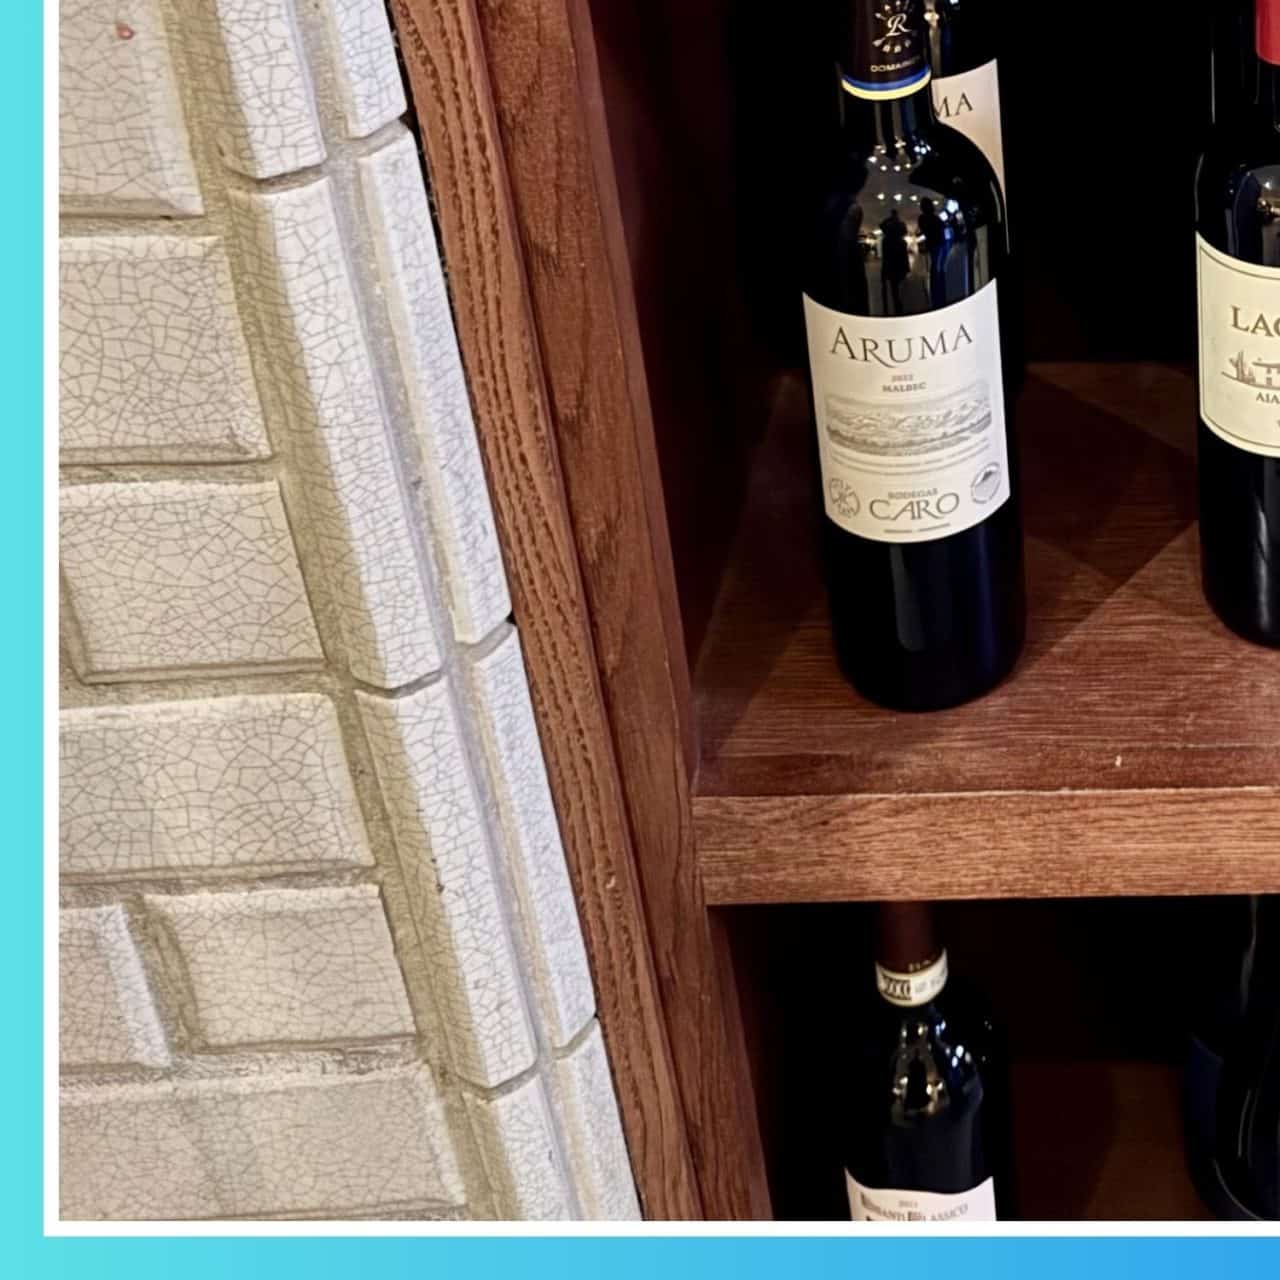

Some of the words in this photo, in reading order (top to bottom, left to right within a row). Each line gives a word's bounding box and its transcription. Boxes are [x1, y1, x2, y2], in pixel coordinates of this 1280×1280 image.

[830, 323, 974, 369] ARUMA
[881, 381, 928, 393] MALBEC
[1255, 391, 1280, 406] AIA
[868, 491, 961, 521] CARO
